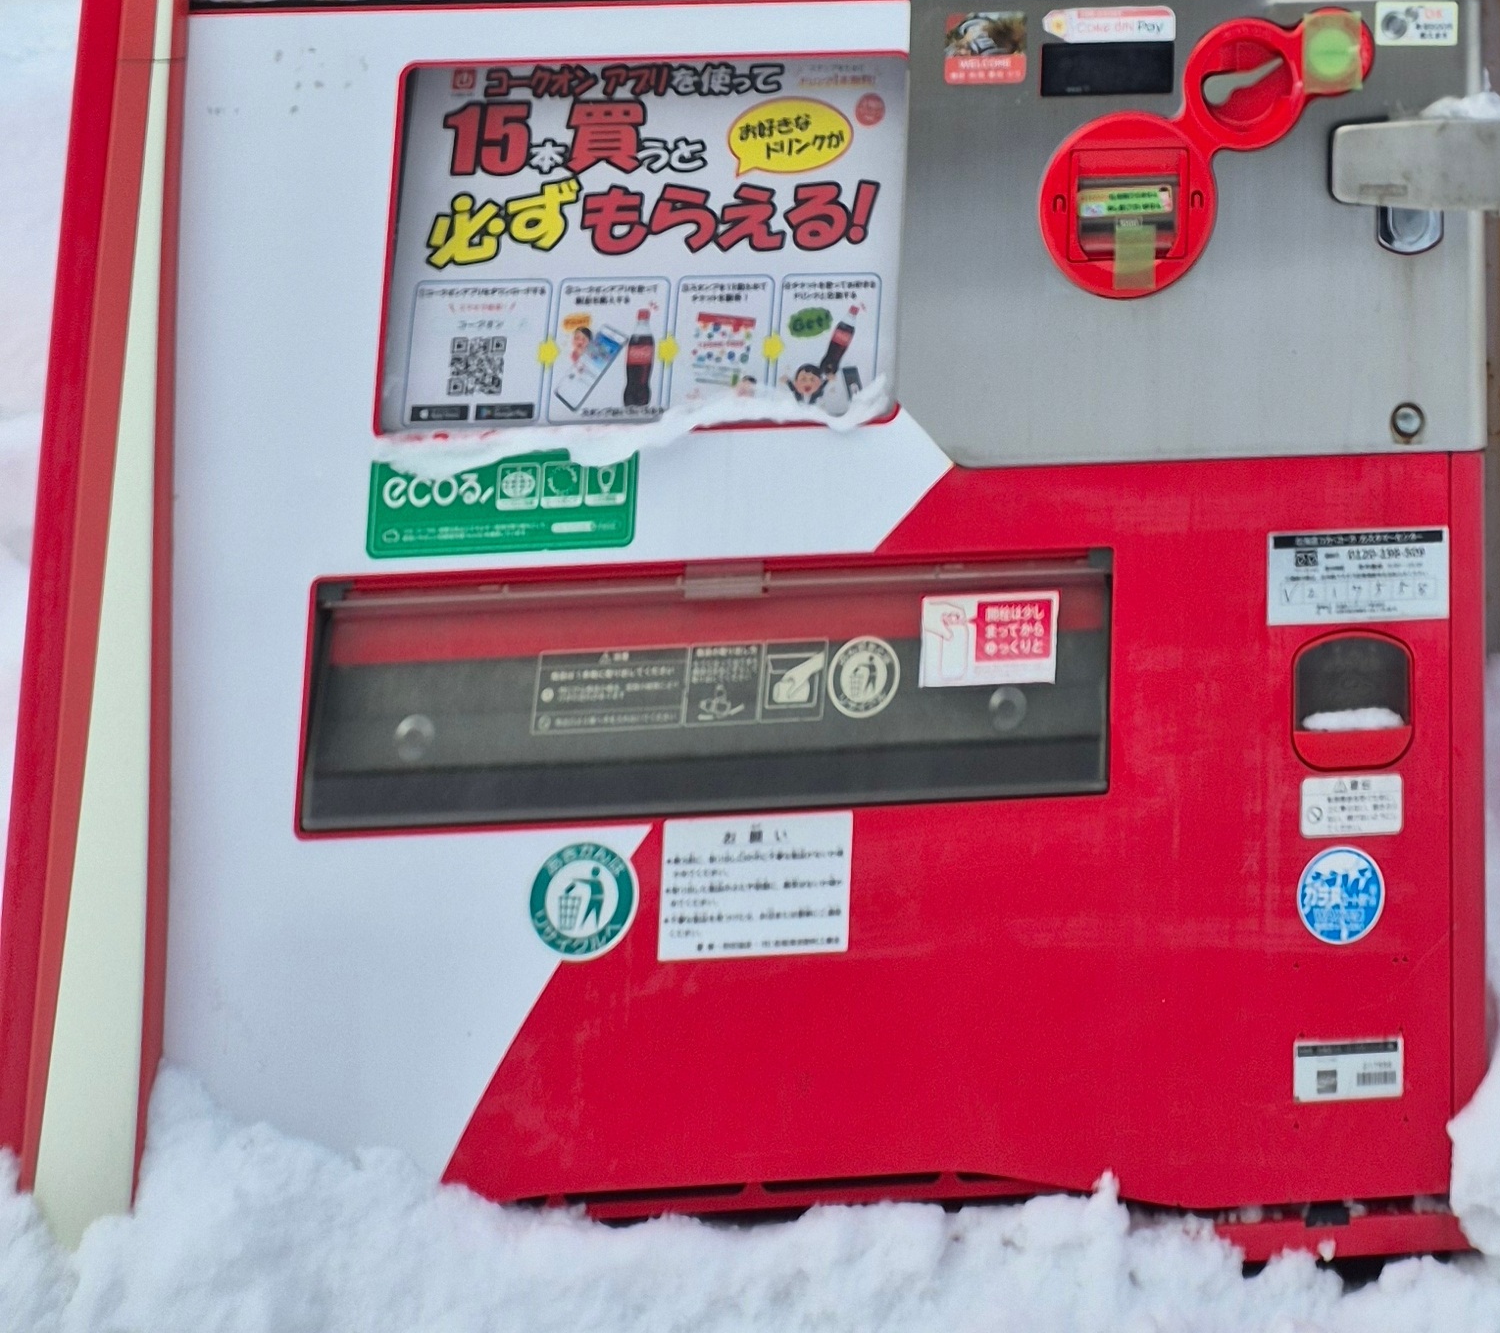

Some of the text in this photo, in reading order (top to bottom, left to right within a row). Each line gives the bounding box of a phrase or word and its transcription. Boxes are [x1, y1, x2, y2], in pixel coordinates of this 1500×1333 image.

[1137, 19, 1168, 35] Pay
[959, 59, 1012, 70] WELCOME
[485, 65, 597, 98] コークオン
[443, 99, 708, 177] 15本買うと
[738, 113, 813, 142] お好きな
[763, 128, 846, 161] ドリンクが
[426, 177, 881, 270] 必ずもらえる!
[984, 622, 1044, 638] まってから
[984, 639, 1044, 656] ゆっくりと
